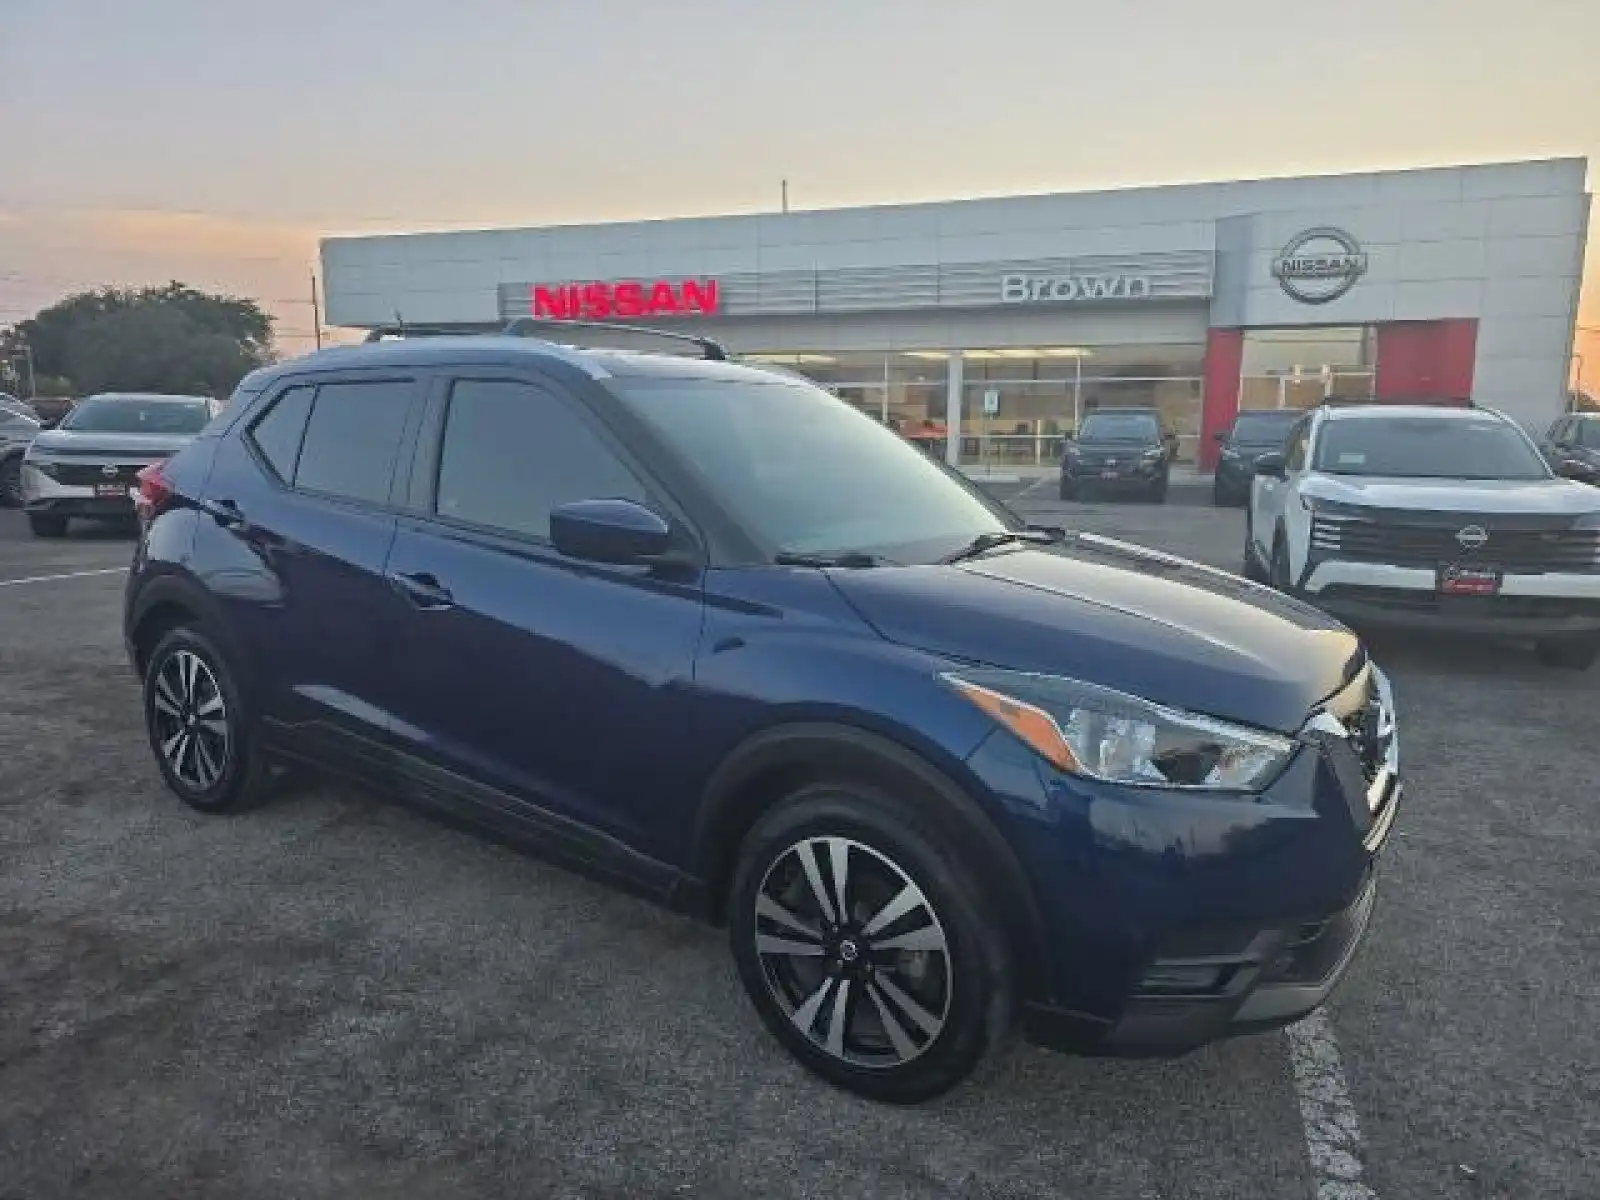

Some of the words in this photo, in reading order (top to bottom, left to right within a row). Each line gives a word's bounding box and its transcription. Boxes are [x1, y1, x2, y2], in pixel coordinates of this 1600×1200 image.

[1281, 258, 1361, 274] NISSAN
[532, 280, 718, 319] NISSAN
[1001, 273, 1151, 301] Brown
